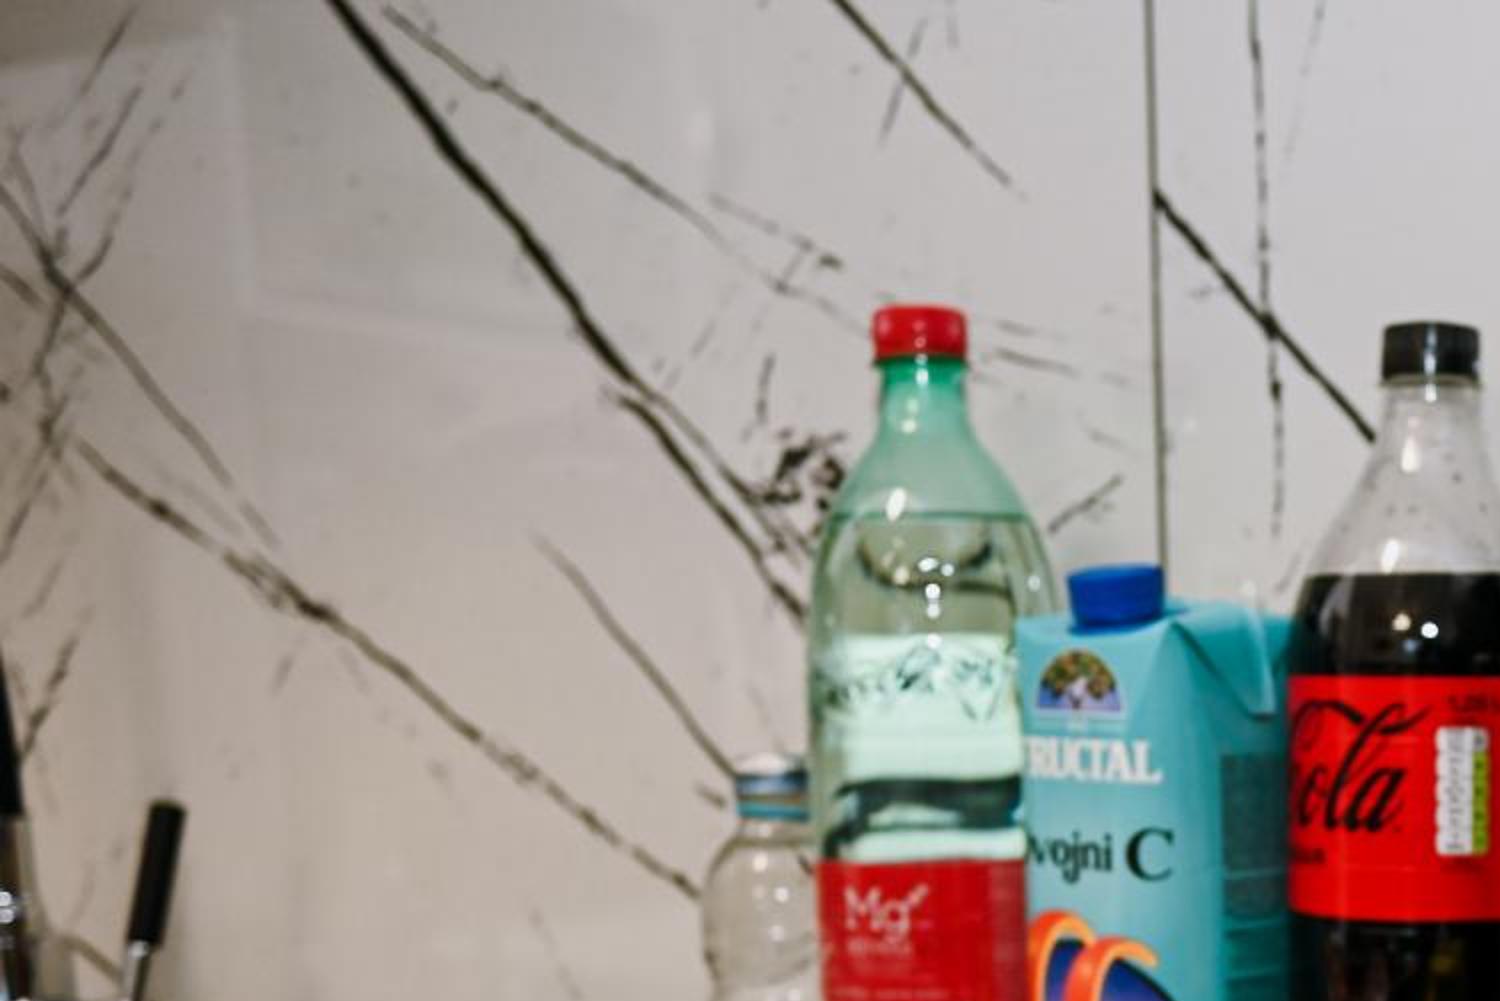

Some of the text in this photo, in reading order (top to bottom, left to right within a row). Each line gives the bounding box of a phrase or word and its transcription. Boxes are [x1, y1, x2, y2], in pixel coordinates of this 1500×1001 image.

[1022, 735, 1165, 785] RUCTAL
[1026, 826, 1175, 884] vojni C
